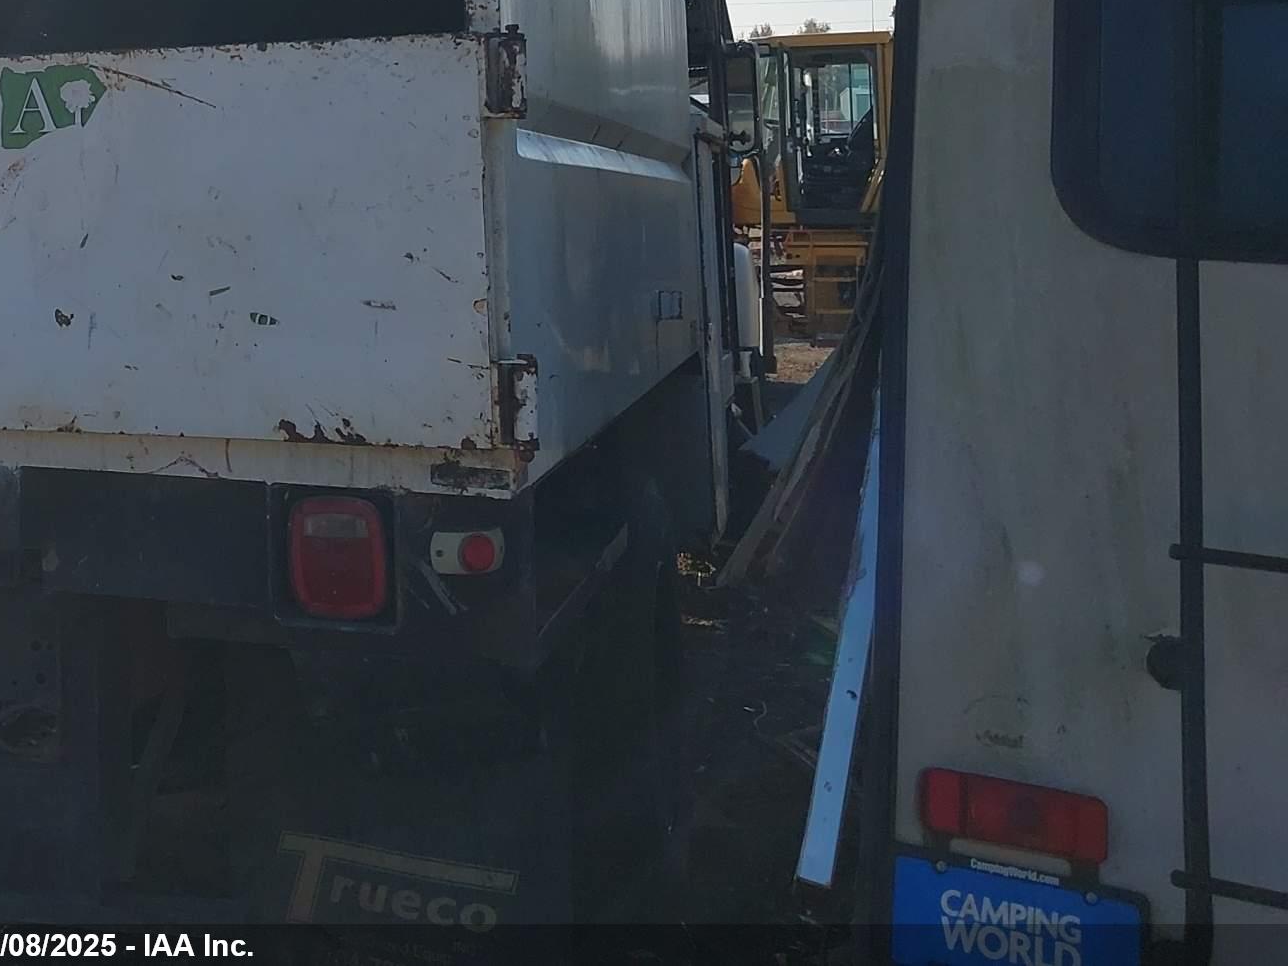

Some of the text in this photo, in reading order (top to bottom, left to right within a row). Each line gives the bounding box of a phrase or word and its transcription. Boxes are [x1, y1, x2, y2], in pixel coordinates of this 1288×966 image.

[9, 77, 57, 134] A
[276, 829, 520, 933] Trueco
[970, 857, 1060, 886] CampingWorld.com
[940, 889, 1081, 944] CAMPING
[941, 915, 1081, 966] WORLD
